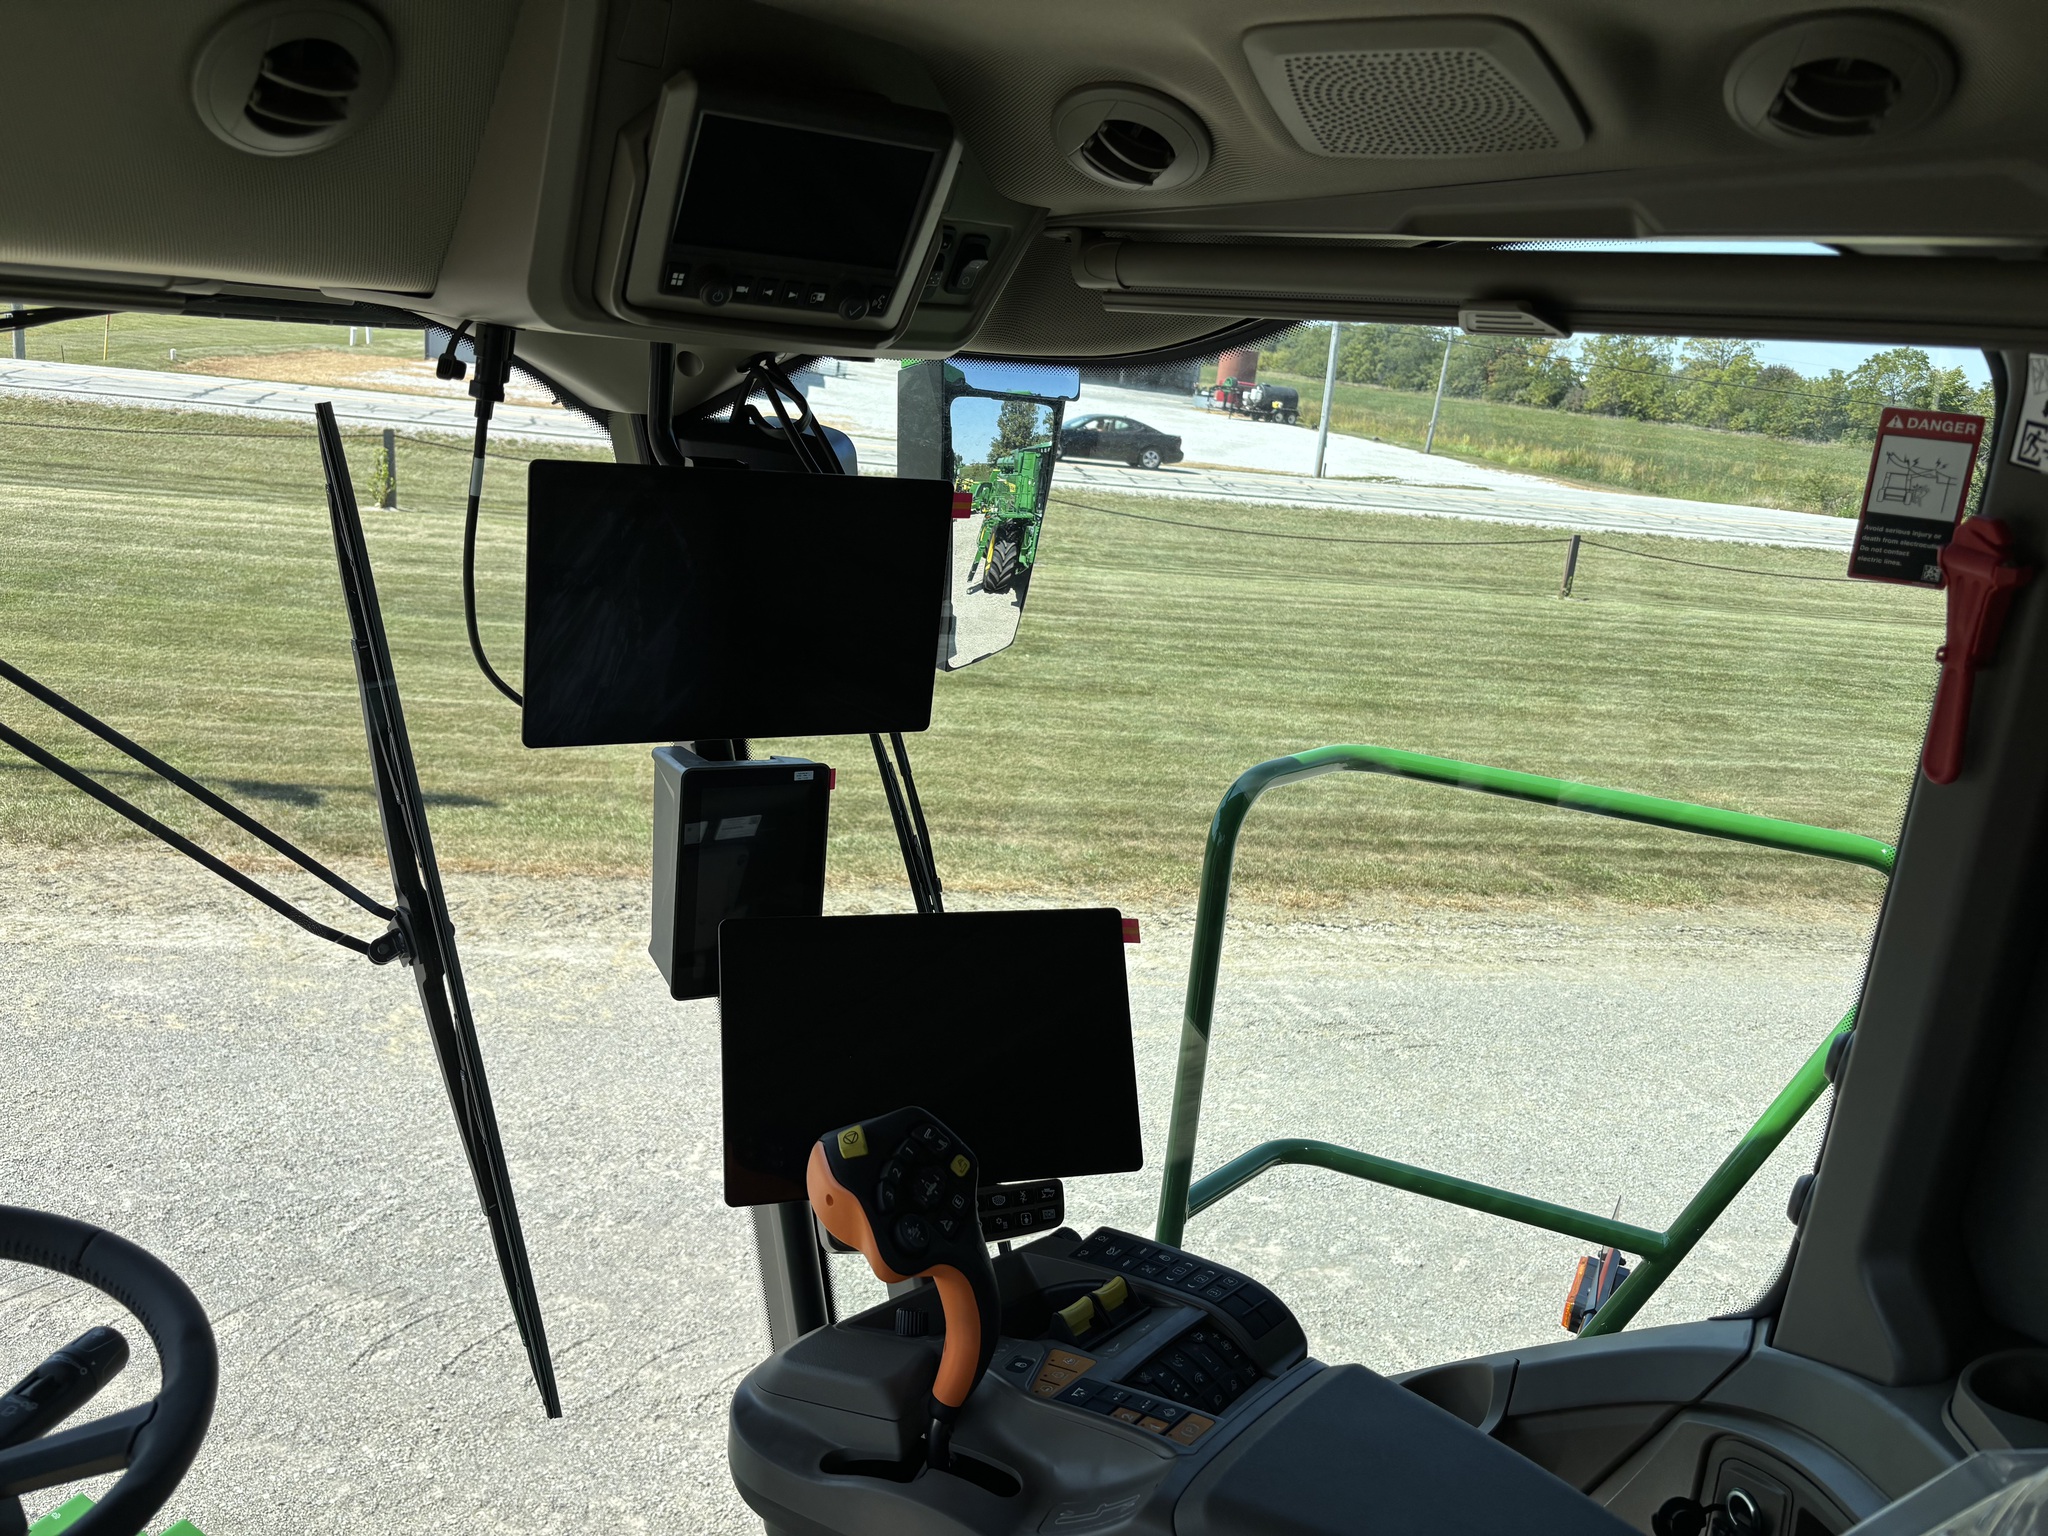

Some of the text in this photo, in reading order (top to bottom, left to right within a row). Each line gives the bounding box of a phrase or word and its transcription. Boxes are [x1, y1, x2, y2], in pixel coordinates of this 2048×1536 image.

[1906, 417, 1977, 435] DANGER
[1864, 524, 1884, 532] Avoid
[1885, 527, 1911, 536] serious
[1912, 530, 1932, 539] injury
[1862, 535, 1881, 543] death
[1882, 537, 1899, 545] from
[1859, 544, 1870, 552] Do
[1883, 548, 1910, 557] contact
[1857, 556, 1902, 567] electric lines.
